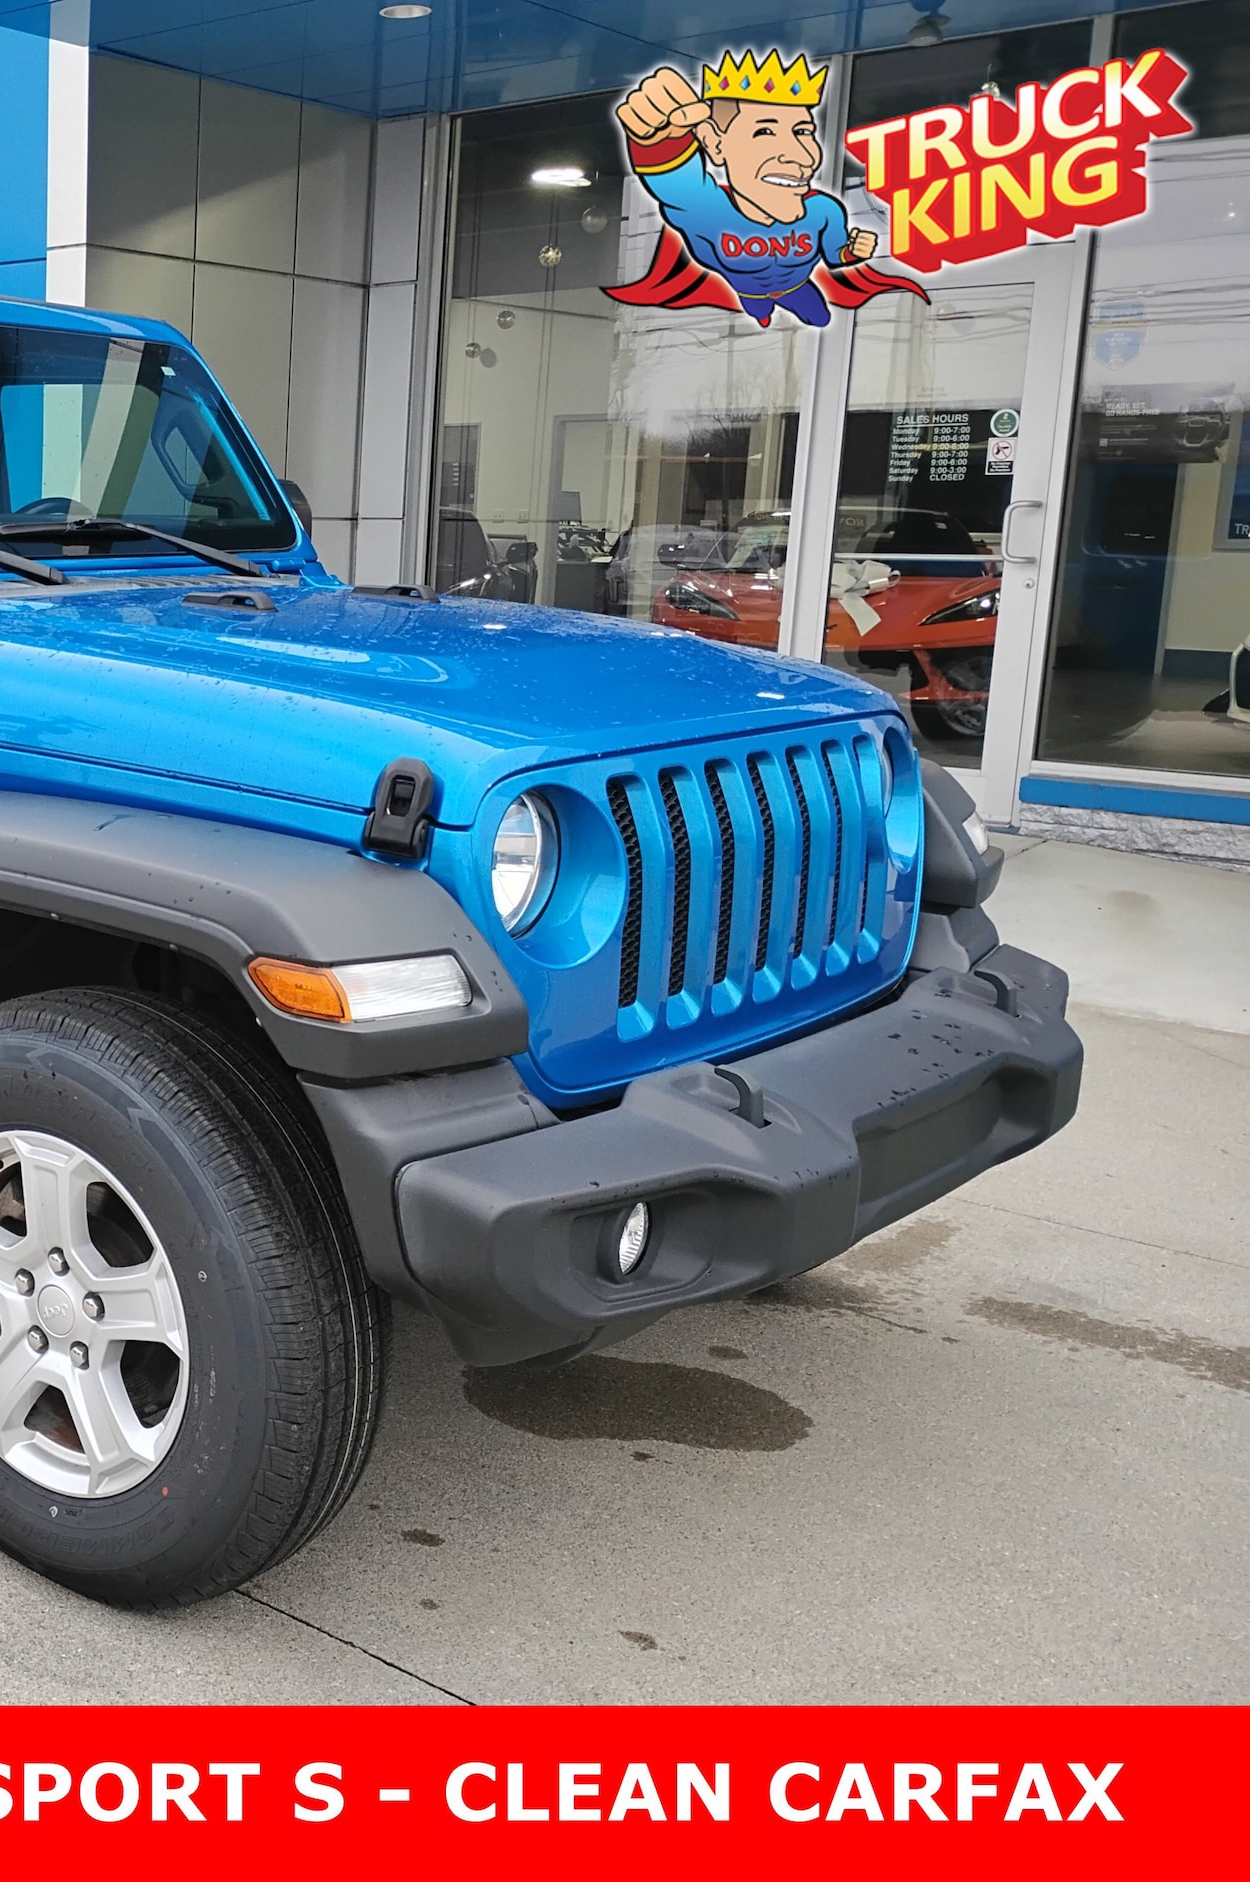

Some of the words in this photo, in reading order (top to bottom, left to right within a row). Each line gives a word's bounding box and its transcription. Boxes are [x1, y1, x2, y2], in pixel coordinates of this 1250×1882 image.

[897, 415, 930, 425] SALES
[932, 413, 969, 424] HOURS
[892, 427, 920, 436] Monday
[892, 435, 920, 443] Tuesday
[891, 443, 931, 452] Wednesday
[891, 451, 922, 459] Thursday
[890, 459, 911, 467] Friday
[888, 467, 919, 475] Saturday
[43, 1302, 69, 1320] Jeep
